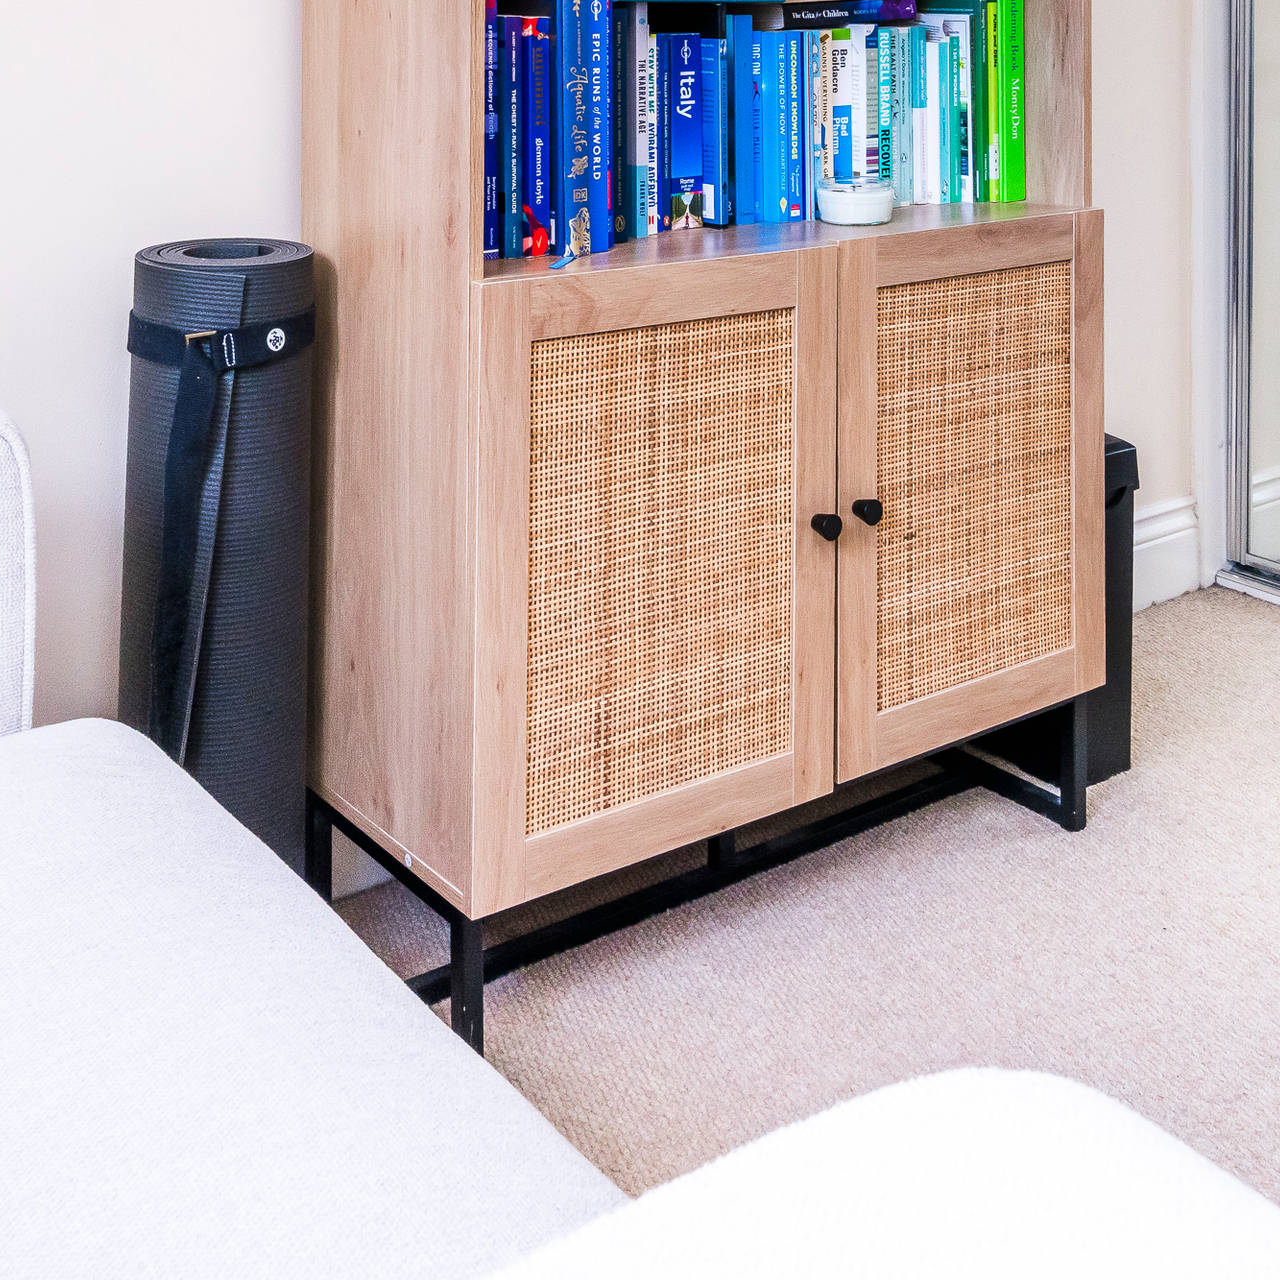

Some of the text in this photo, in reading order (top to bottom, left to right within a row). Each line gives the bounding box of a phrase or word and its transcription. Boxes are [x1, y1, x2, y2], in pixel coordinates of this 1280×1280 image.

[791, 9, 849, 20] The Gita Children
[487, 30, 495, 104] FREQUENCY dictionary
[648, 47, 656, 114] STAY WITH ME
[821, 40, 829, 122] AGAINST EVERYTHING
[831, 49, 839, 94] Goldacre
[840, 48, 848, 68] Ben
[879, 32, 890, 84] RUSSELL
[1008, 44, 1019, 72] Book
[566, 66, 589, 122] Aquatic
[592, 33, 601, 181] EPIC RUNS of the WORLD
[638, 59, 647, 134] THE NARRATIVE AGE
[676, 70, 696, 118] Italy
[778, 43, 786, 136] THE POWER OF NOW
[790, 40, 798, 160] UNCOMMON KNOWLEDGE
[879, 85, 890, 126] BRAND
[1010, 78, 1021, 140] Monty Don
[570, 124, 588, 153] Life
[832, 117, 841, 155] Pharma
[840, 116, 849, 137] Bad
[534, 138, 544, 205] glennon doyle
